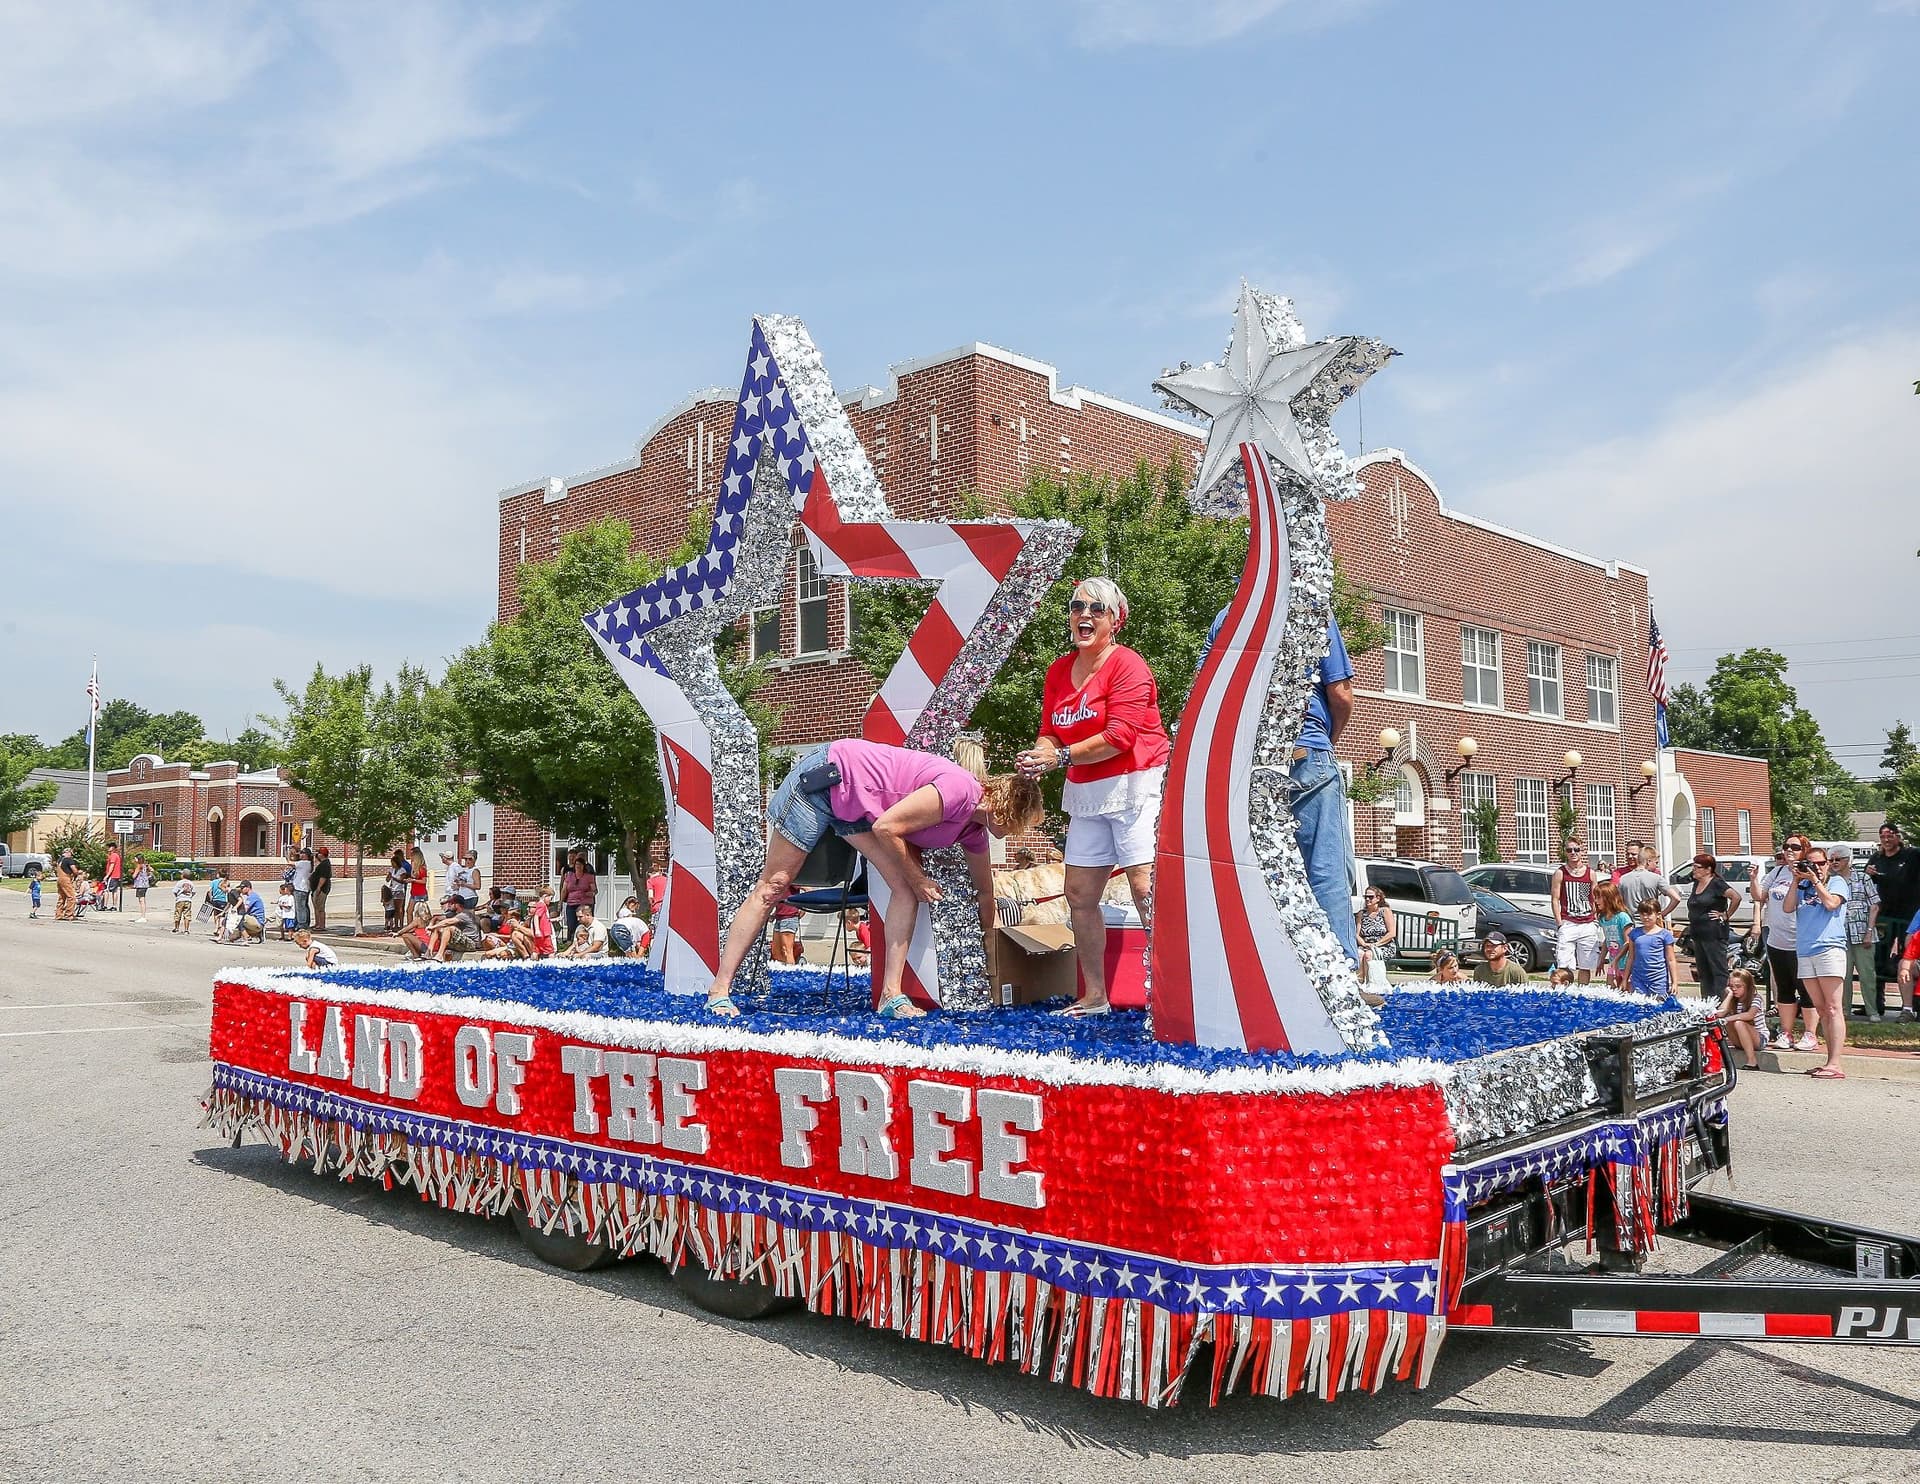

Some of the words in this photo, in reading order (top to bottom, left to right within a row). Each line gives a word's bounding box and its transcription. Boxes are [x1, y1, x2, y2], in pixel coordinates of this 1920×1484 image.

[1051, 692, 1093, 726] rdials
[288, 1002, 424, 1101] LAND
[454, 1025, 535, 1116] OF
[561, 1045, 710, 1155] THE
[774, 1067, 1046, 1209] FREE
[1835, 1306, 1902, 1337] PJ
